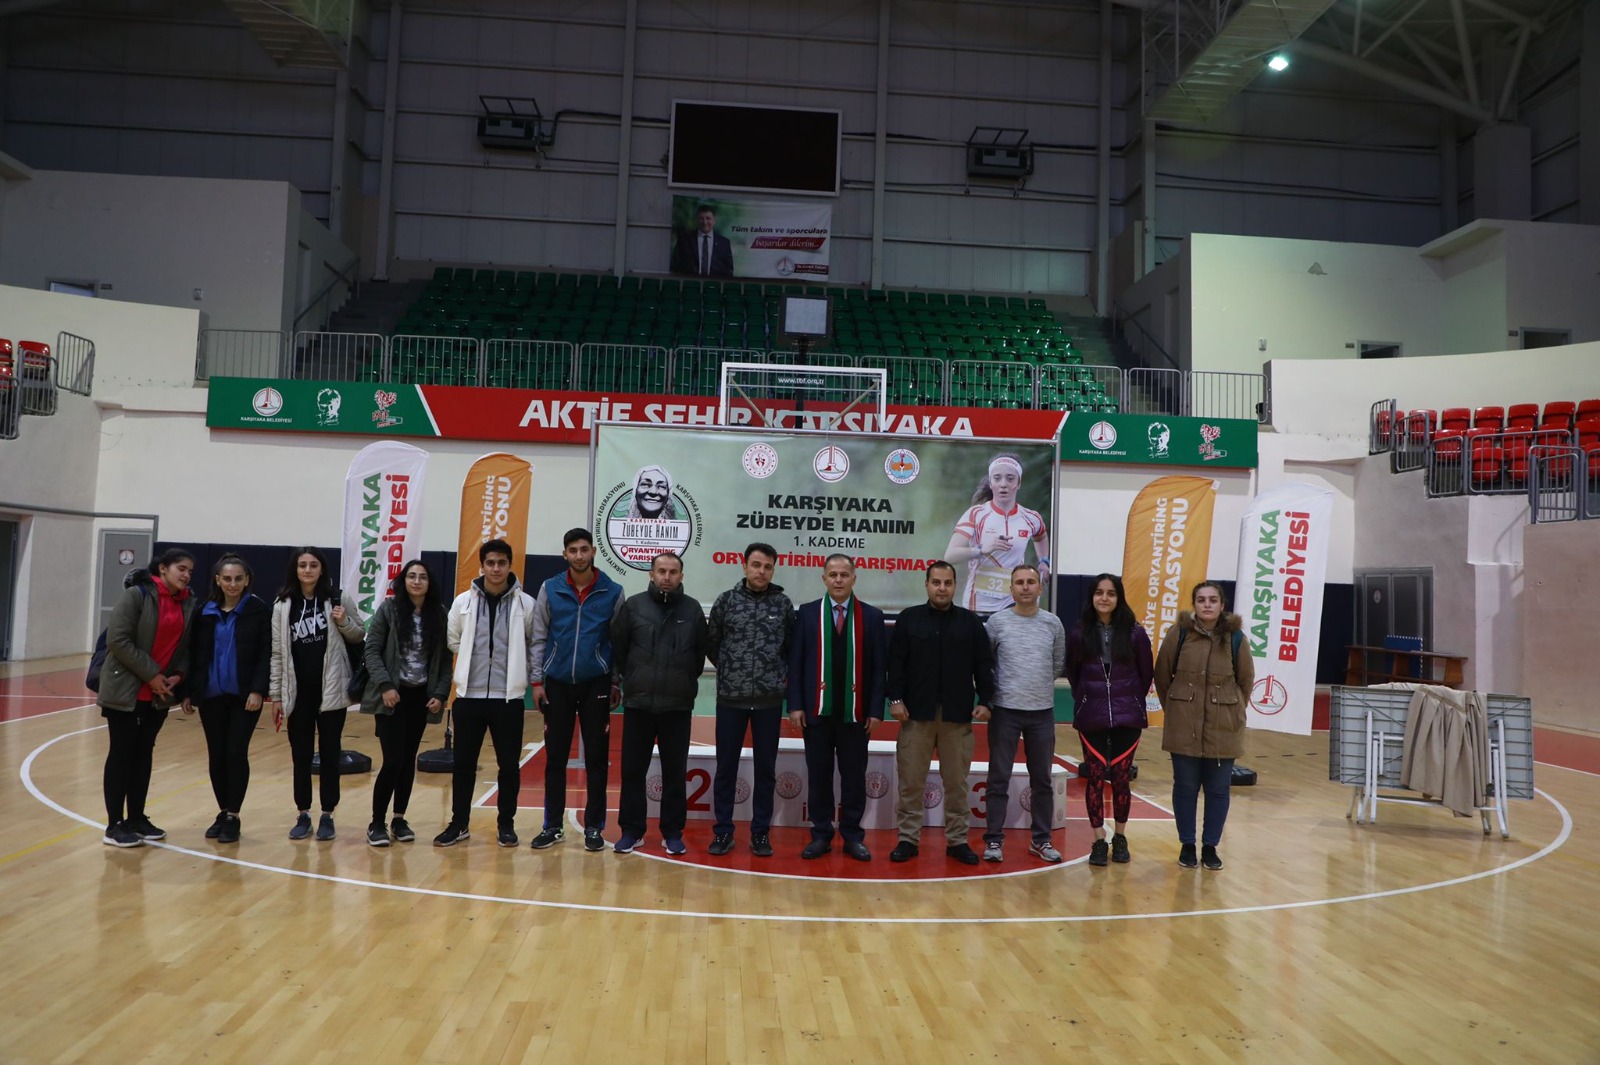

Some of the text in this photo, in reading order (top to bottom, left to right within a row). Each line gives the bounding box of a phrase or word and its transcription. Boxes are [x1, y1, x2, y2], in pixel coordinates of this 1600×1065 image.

[786, 227, 828, 235] sporculara
[598, 481, 626, 517] FEDERASYONU
[676, 483, 703, 546] KARŞIYAKA BELEDİYESİ
[768, 494, 893, 514] KARŞIYAKA
[656, 524, 678, 539] HANIM
[736, 511, 915, 534] ZÜBEYDE HANIM
[358, 472, 382, 633] ARŞIYAKA
[794, 536, 865, 548] 1. KADEME
[1148, 497, 1168, 598] ORYANTİRİNG
[988, 578, 1004, 592] 32
[1249, 510, 1280, 658] KARŞIYAKA
[1278, 511, 1310, 662] BELEDİYESİ
[684, 768, 711, 812] 2
